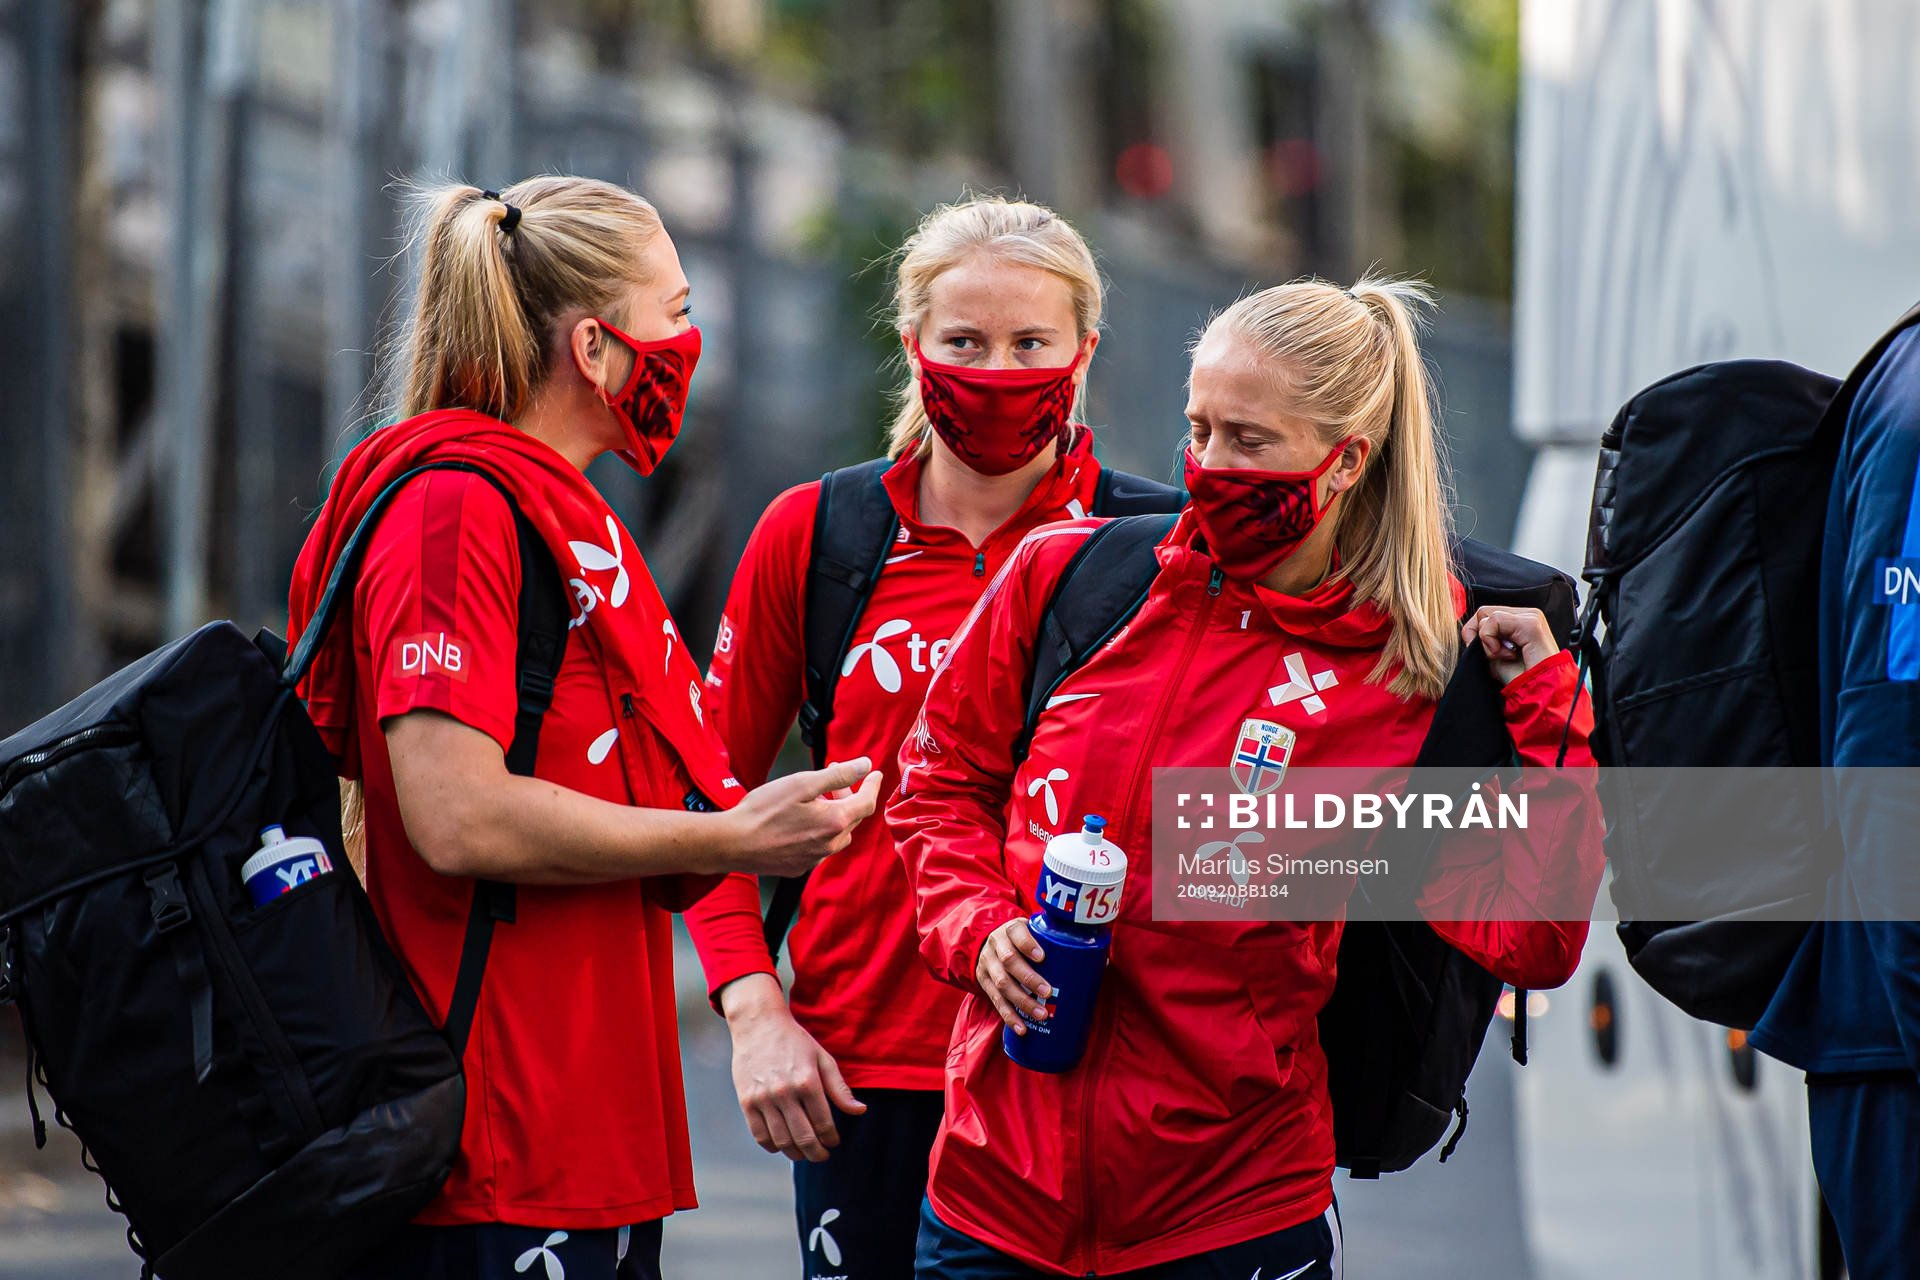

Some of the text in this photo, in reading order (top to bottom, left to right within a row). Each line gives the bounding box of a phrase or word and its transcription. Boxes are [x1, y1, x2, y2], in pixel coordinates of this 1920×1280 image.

[402, 632, 462, 676] DNB
[907, 633, 951, 672] te
[1261, 724, 1279, 734] NORGE
[1089, 850, 1111, 867] 15
[1085, 887, 1116, 919] 15
